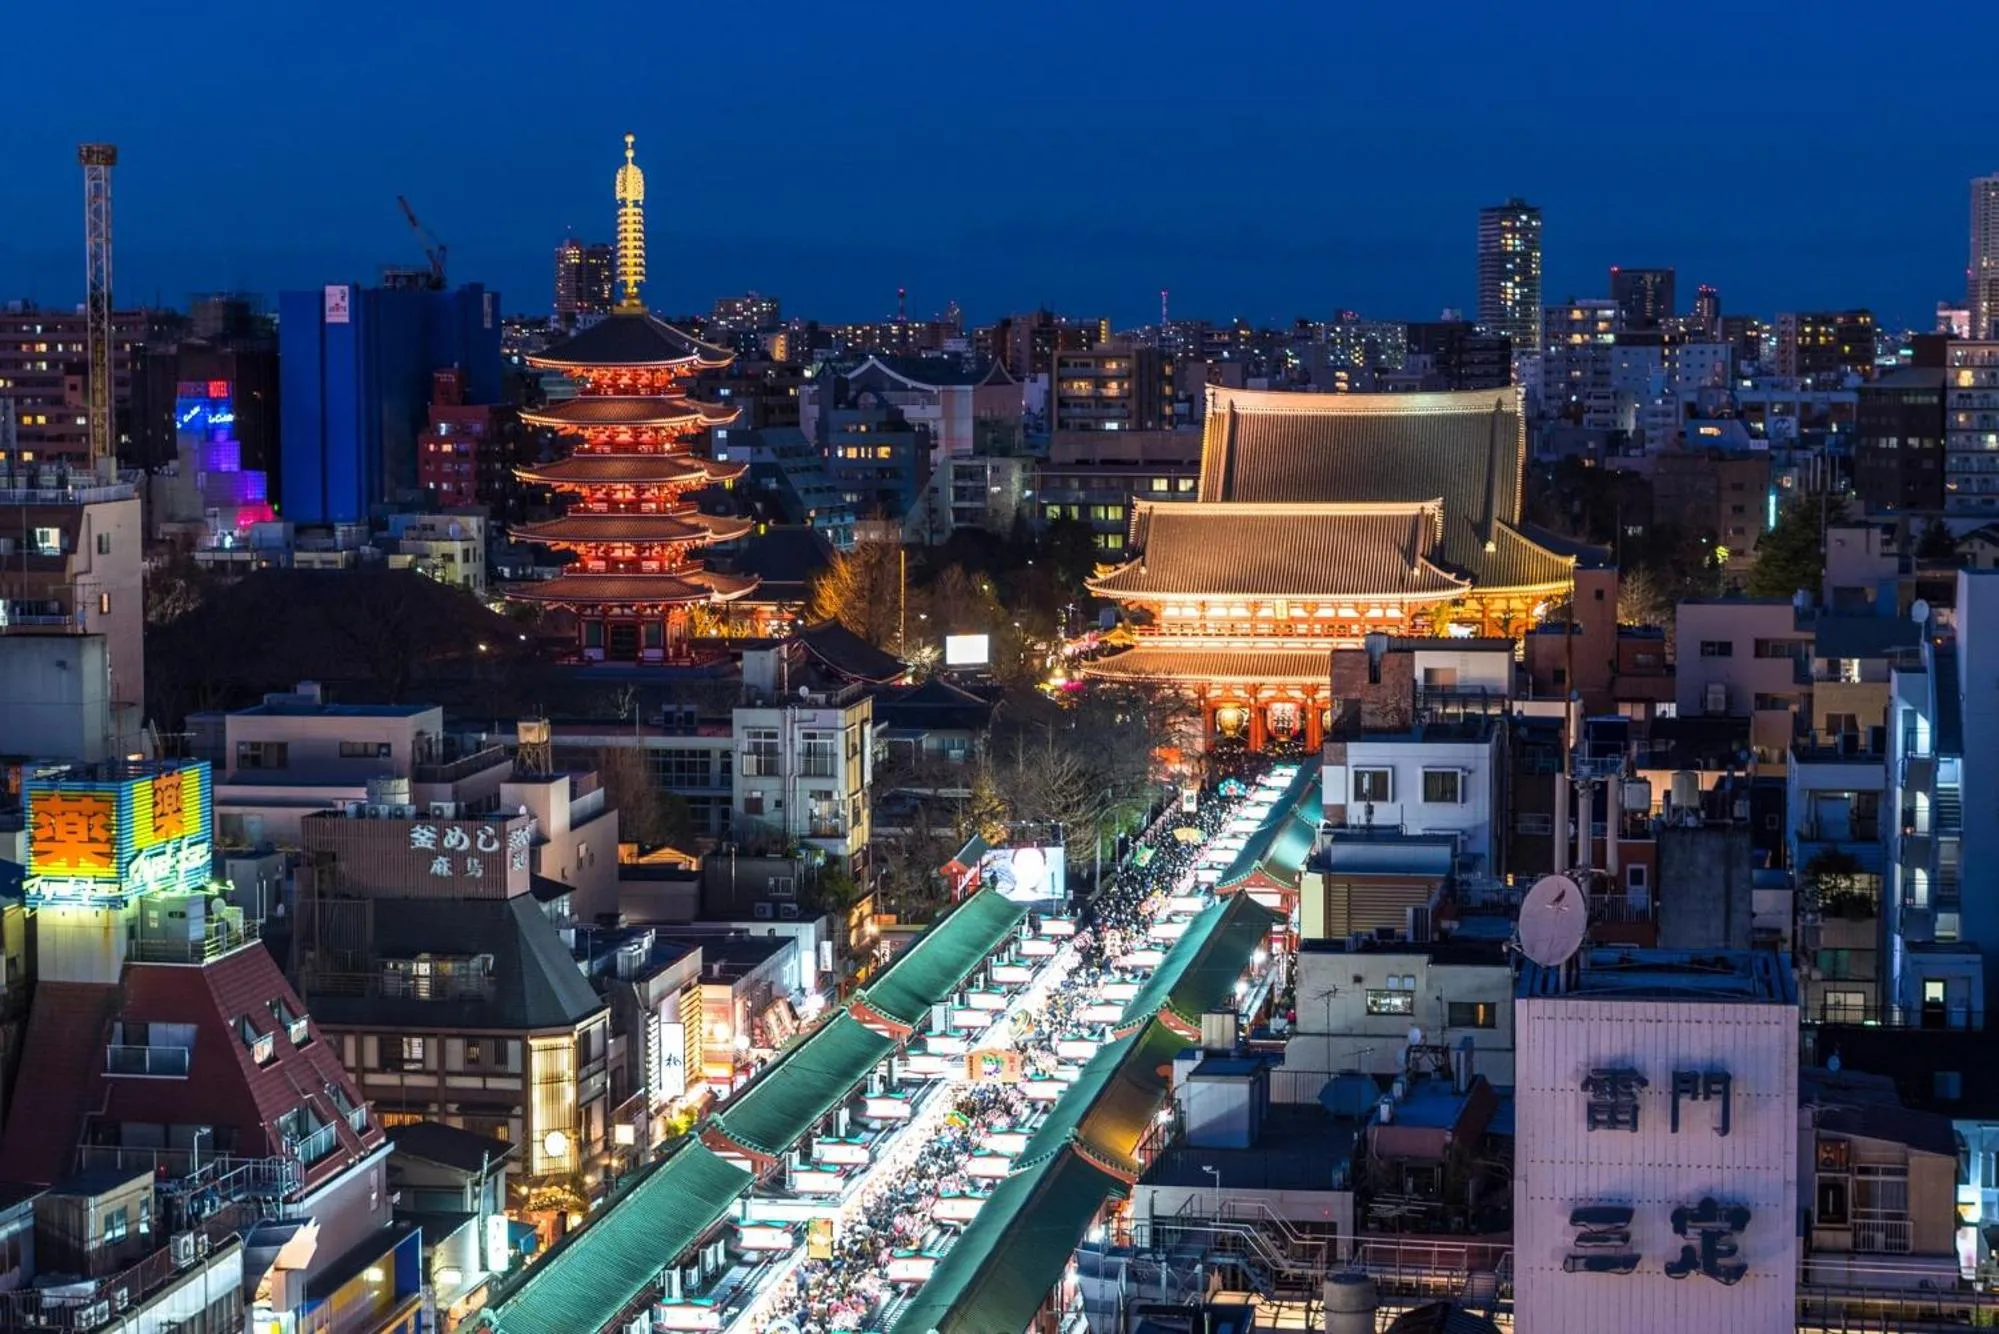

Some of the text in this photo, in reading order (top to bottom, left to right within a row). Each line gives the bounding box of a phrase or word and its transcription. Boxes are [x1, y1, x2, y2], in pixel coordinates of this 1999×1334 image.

[31, 790, 113, 868] 薬
[152, 769, 185, 840] 薬
[409, 824, 500, 852] 釜めし
[1579, 1067, 1732, 1136] 雷門
[1562, 1197, 1751, 1286] 三定
